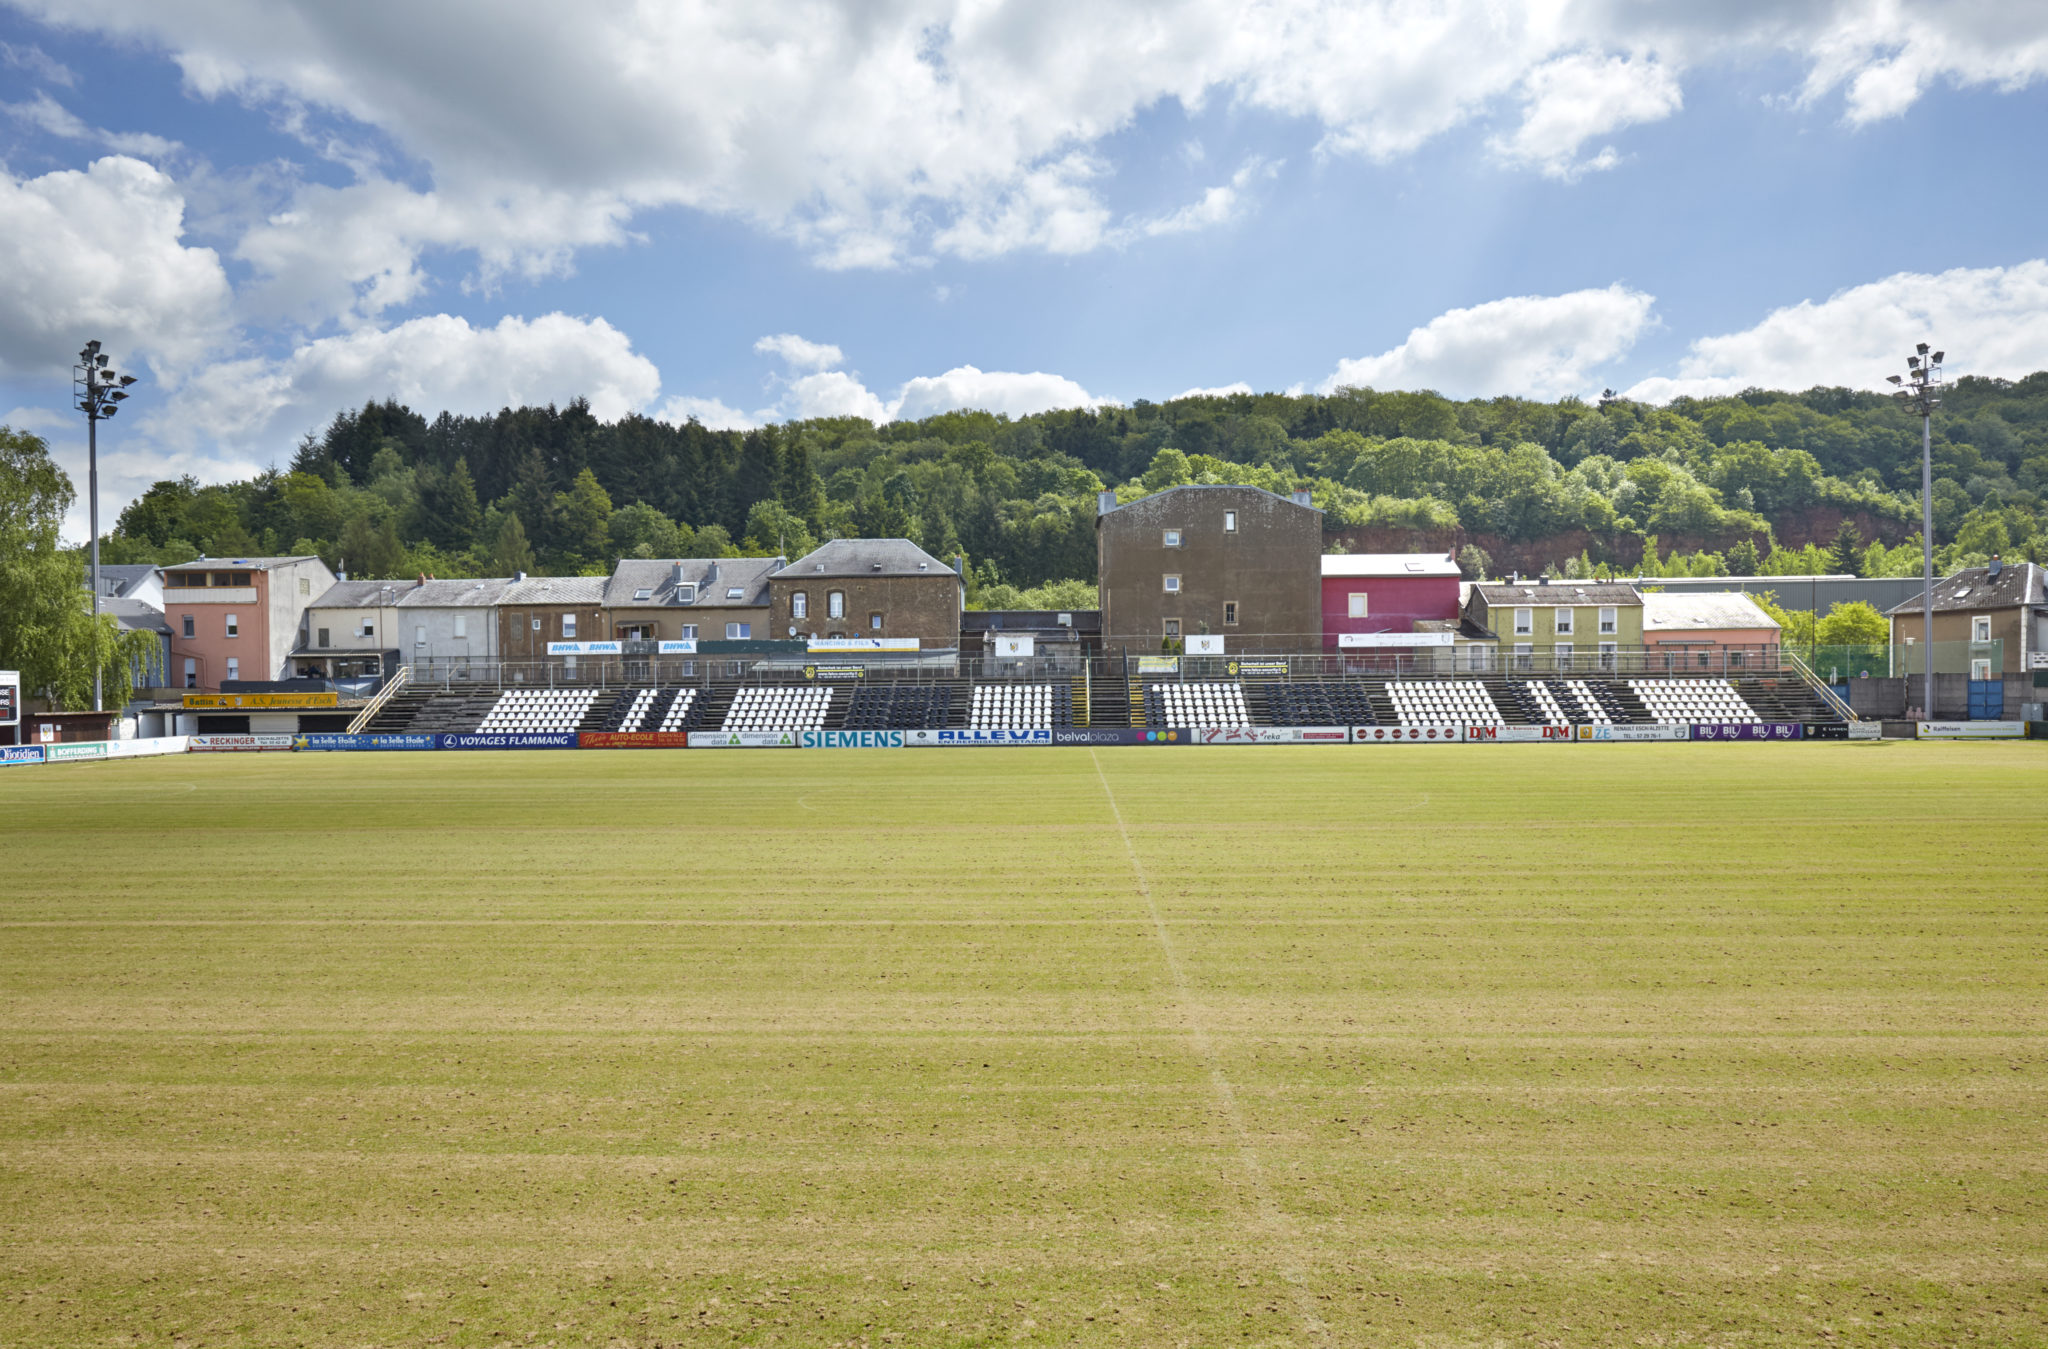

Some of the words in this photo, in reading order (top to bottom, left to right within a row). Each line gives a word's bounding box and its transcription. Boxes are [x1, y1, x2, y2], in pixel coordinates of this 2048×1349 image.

[189, 697, 214, 706] Battin
[1700, 726, 1713, 735] BIL
[1723, 726, 1736, 735] BIL
[1752, 726, 1766, 734] BIL
[1775, 725, 1790, 734] BIL
[312, 736, 319, 744] la
[320, 736, 336, 744] Belle
[337, 736, 356, 744] Etoile
[380, 736, 387, 744] la
[388, 736, 404, 744] Belle
[405, 736, 425, 744] Etoile
[460, 736, 506, 745] VOYAGES
[509, 735, 568, 745] FLAMMANG
[610, 733, 654, 741] AUTO-ECOLE
[803, 731, 903, 748] SIEMENS
[938, 731, 1051, 740] ALLEVA
[1264, 732, 1281, 740] reka
[209, 737, 256, 745] RECKINGER
